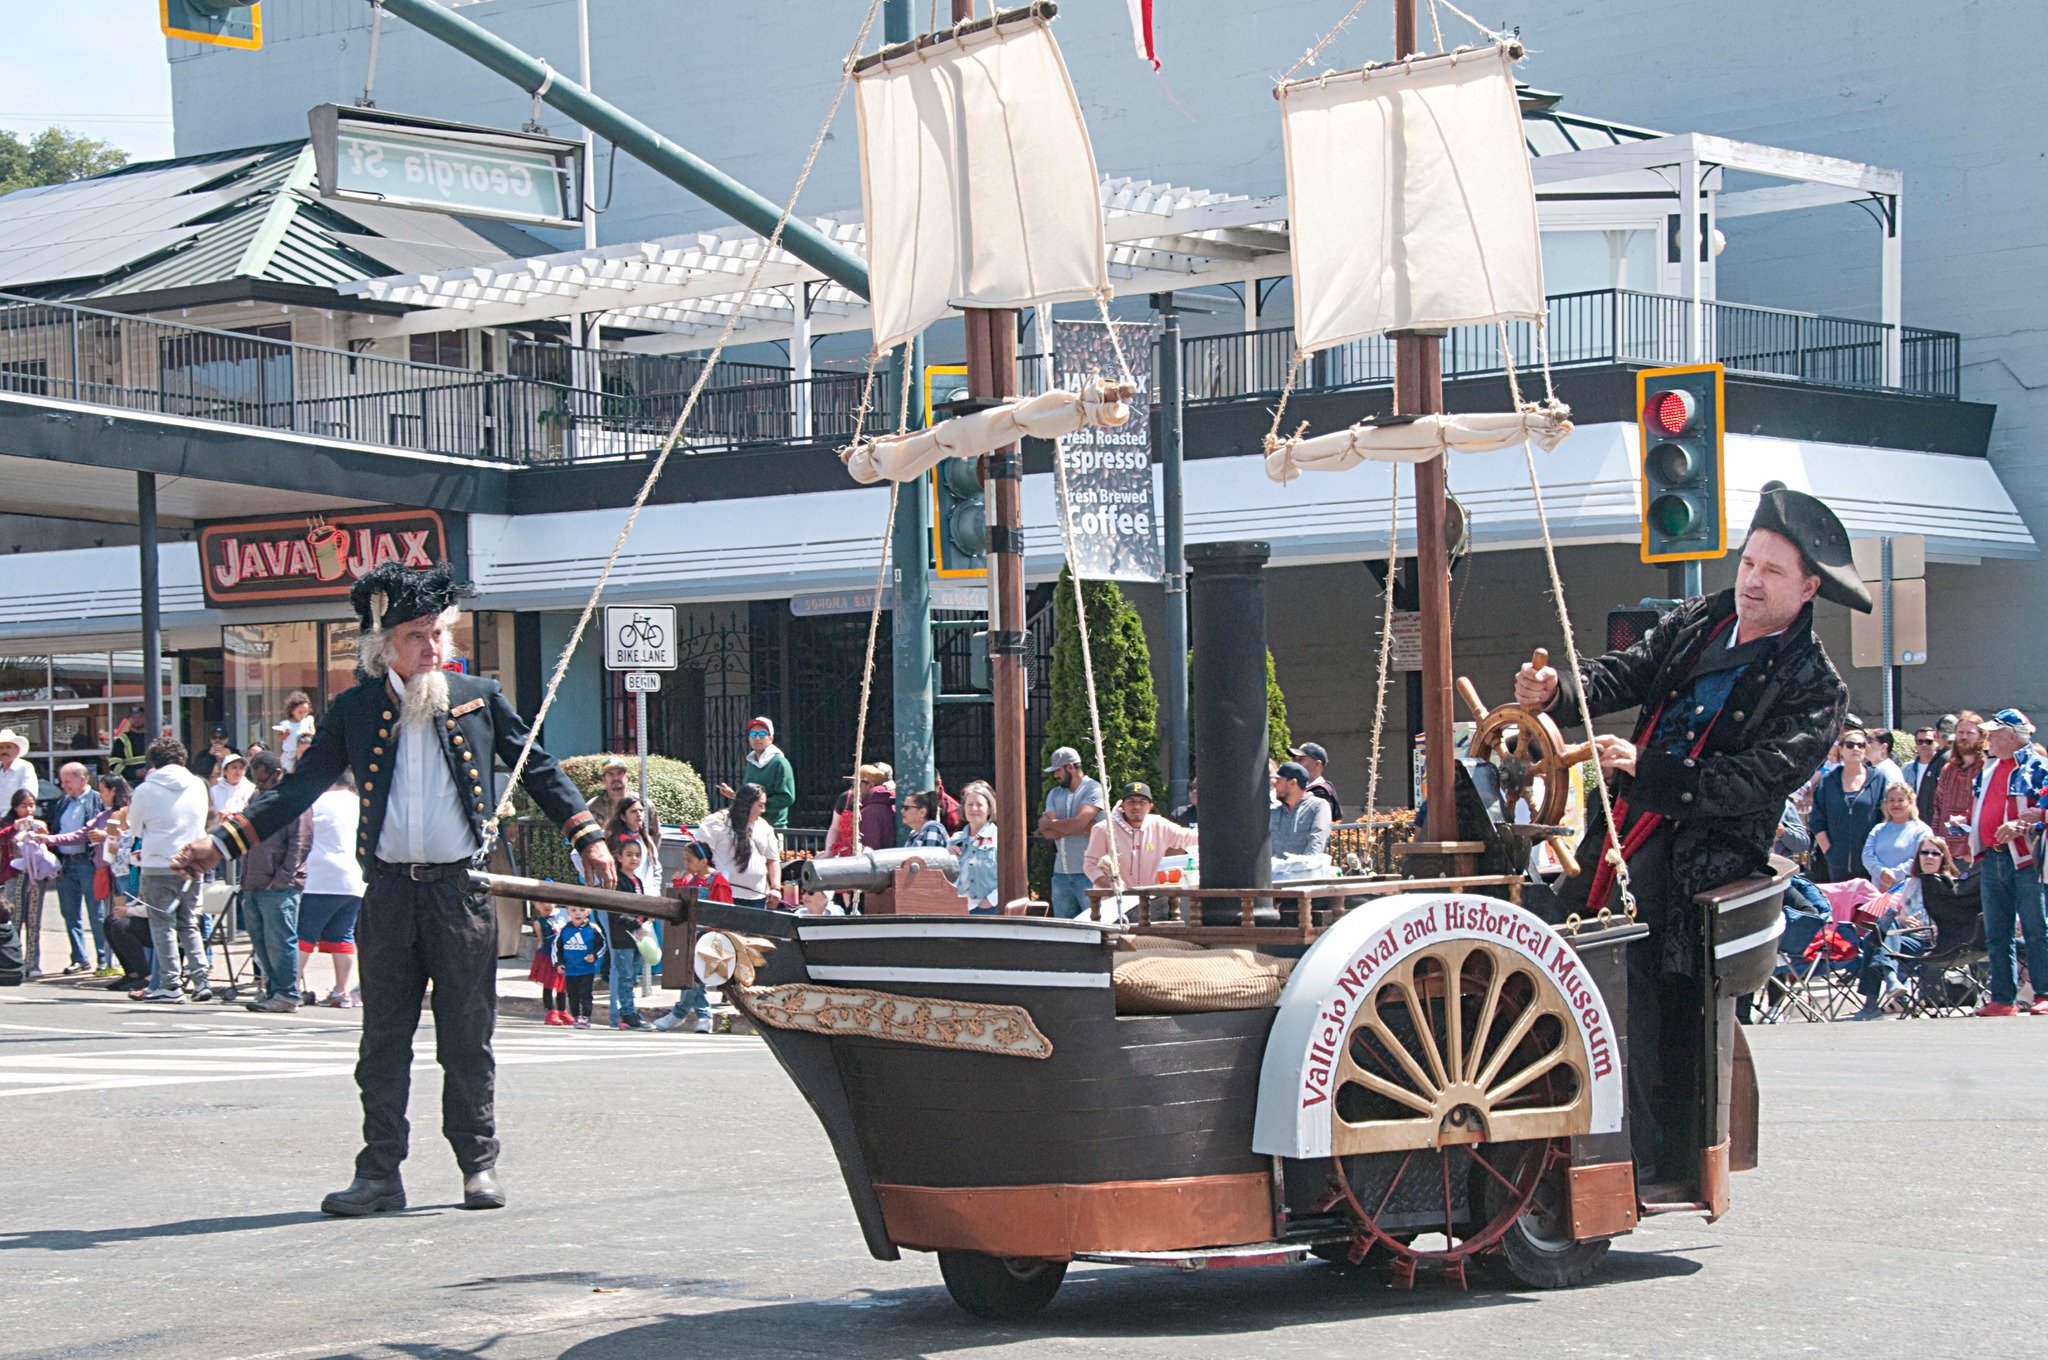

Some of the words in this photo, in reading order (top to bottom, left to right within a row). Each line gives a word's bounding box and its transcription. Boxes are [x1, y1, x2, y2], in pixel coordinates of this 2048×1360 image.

[1096, 430, 1147, 446] Roasted
[1063, 446, 1147, 475] Espresso
[1067, 488, 1098, 503] resh
[1100, 489, 1147, 503] Brewed
[1068, 505, 1150, 535] Coffee
[215, 539, 320, 588] JAVA
[349, 529, 434, 579] JAX
[617, 650, 639, 662] BIKE
[642, 650, 666, 662] LANE
[628, 677, 657, 689] BEGIN
[1134, 783, 1142, 792] P
[1303, 999, 1347, 1108] Vallejo
[1337, 928, 1399, 1000] Naval
[1403, 906, 1437, 945] and
[1444, 902, 1553, 960] Historical
[1548, 947, 1612, 1080] Museum
